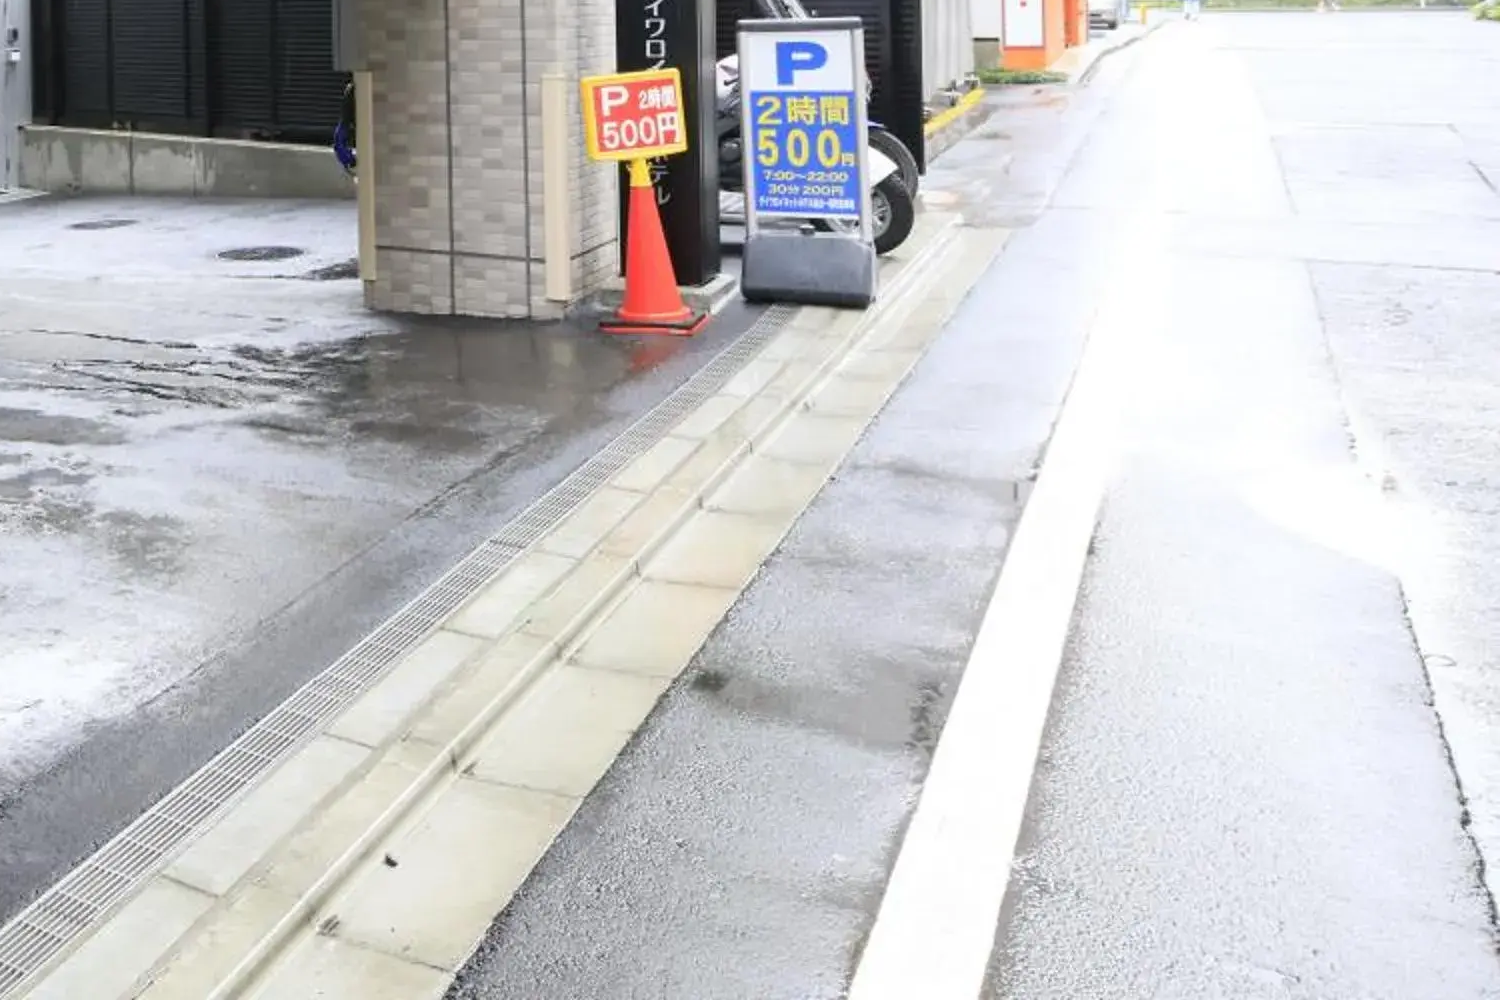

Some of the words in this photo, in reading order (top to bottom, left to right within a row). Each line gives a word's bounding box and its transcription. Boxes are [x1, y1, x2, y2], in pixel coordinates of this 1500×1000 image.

[775, 41, 828, 86] P
[600, 85, 630, 117] P
[638, 85, 677, 110] 2時間
[756, 95, 849, 126] 2時間
[602, 111, 681, 149] 500円
[757, 128, 855, 169] 500円
